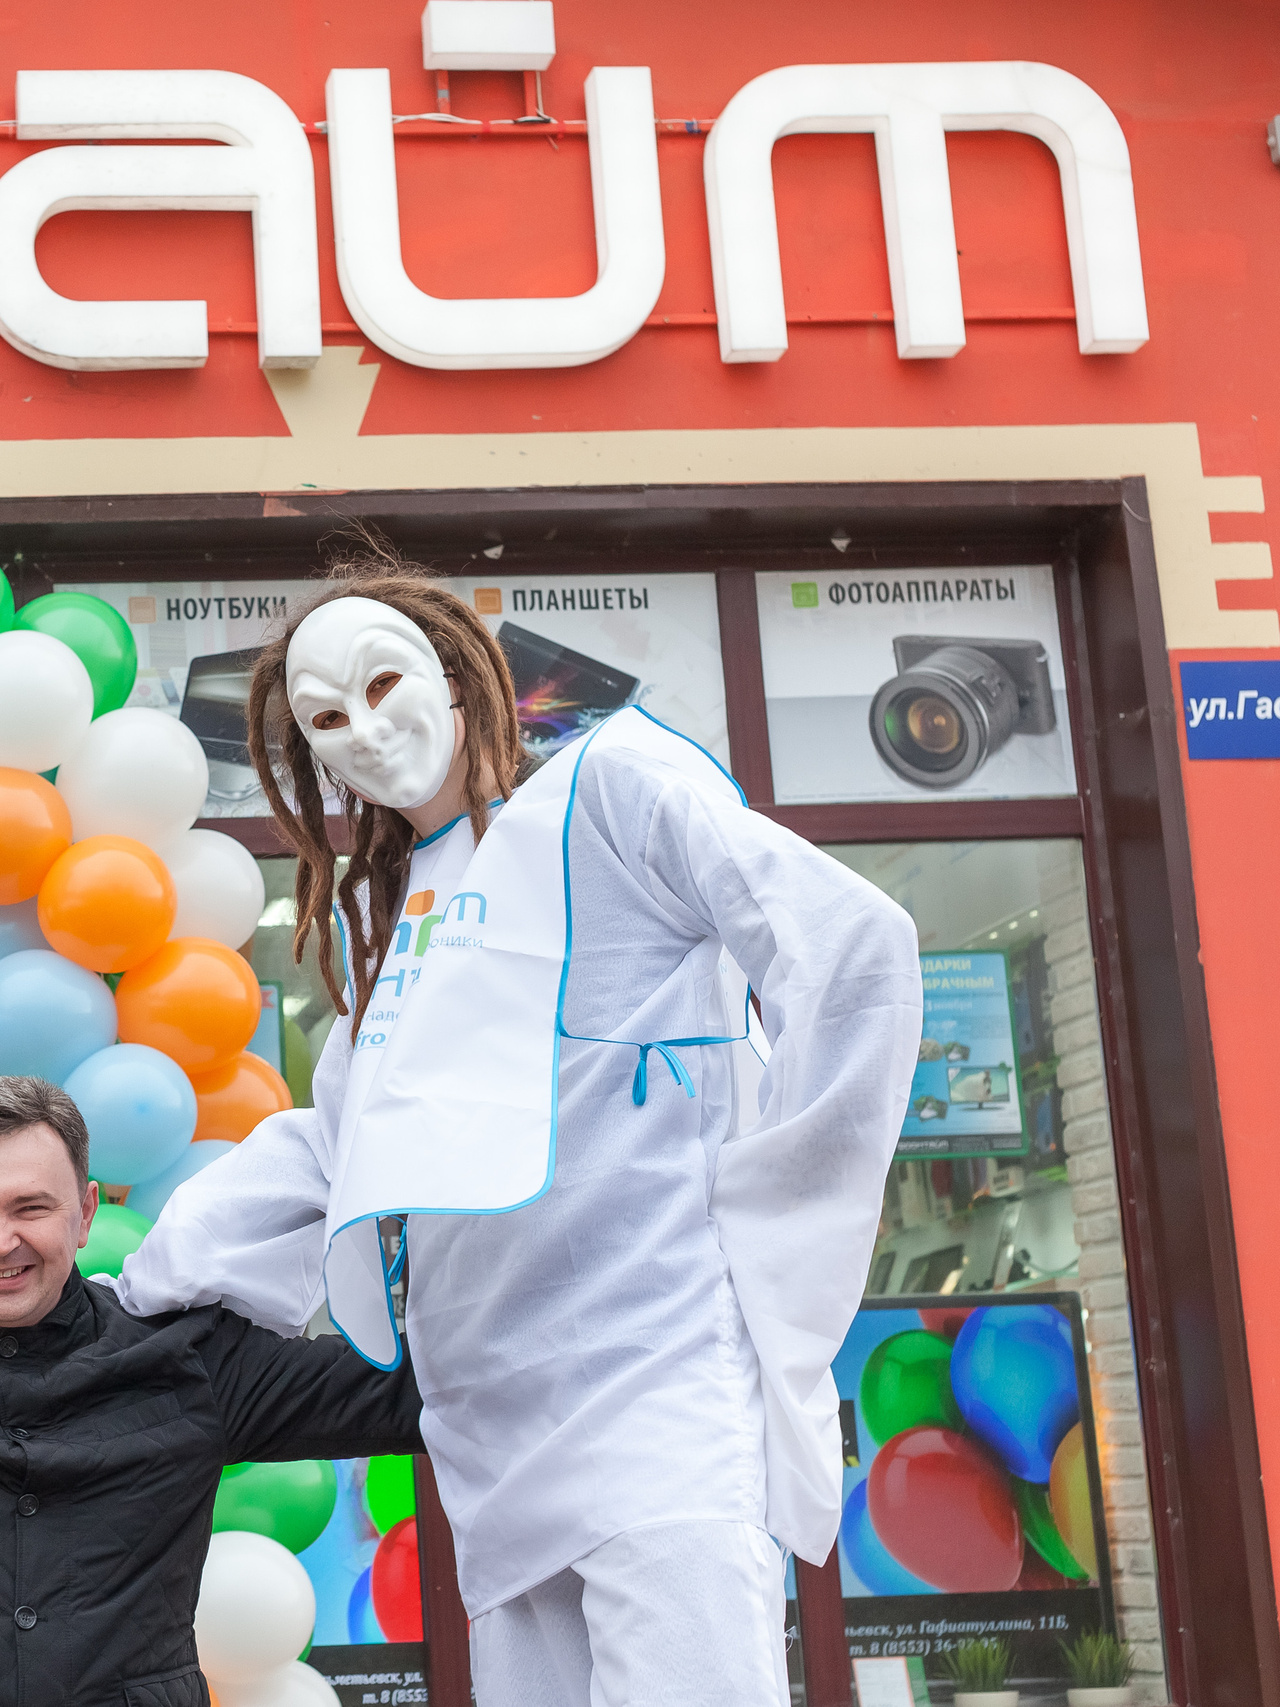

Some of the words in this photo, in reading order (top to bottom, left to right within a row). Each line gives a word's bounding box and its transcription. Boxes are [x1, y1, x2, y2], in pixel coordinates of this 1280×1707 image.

[512, 587, 649, 611] ПЛАНШЕТЫ
[828, 578, 1016, 606] ФОТОАППАРАТЫ
[166, 595, 287, 621] НОУТБУКИ
[895, 1621, 916, 1639] ул.
[870, 1641, 880, 1655] 8
